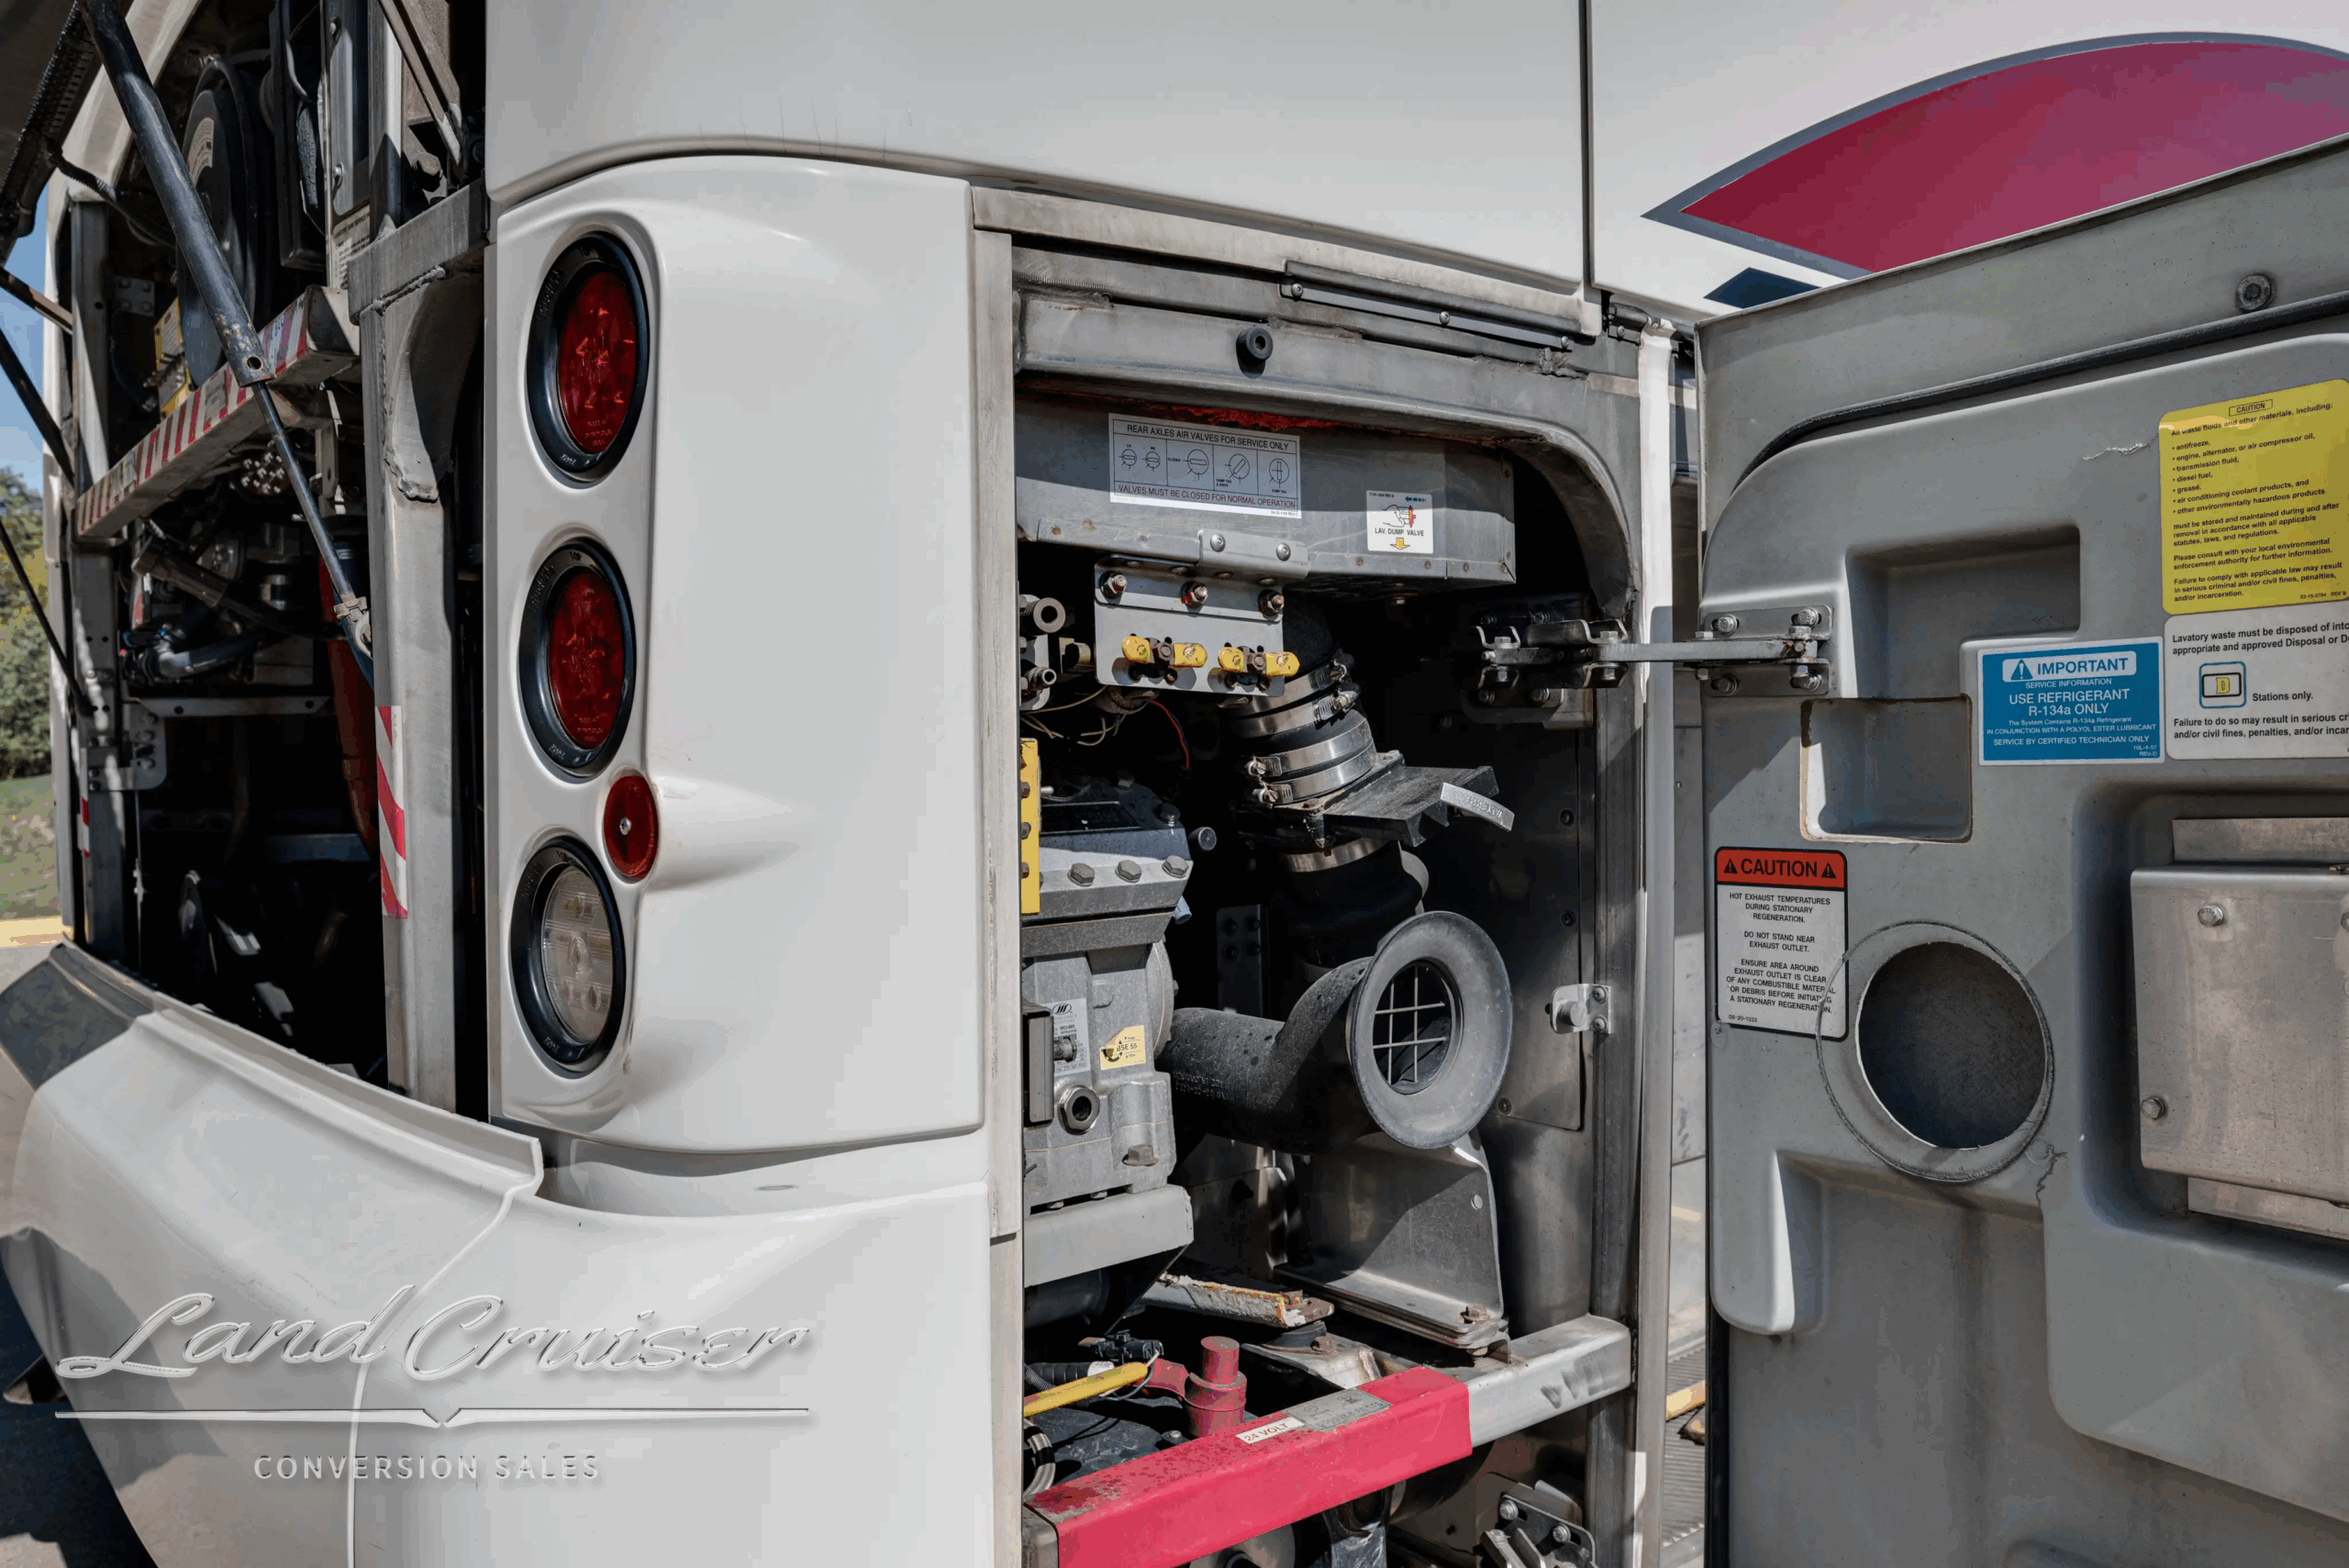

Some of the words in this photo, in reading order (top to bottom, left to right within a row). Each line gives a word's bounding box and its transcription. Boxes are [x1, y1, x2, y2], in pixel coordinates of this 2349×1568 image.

[2236, 402, 2266, 414] CAUTION
[1127, 424, 1148, 434] REAR
[1150, 427, 1174, 437] AXLES
[1176, 430, 1188, 439] AIR
[1190, 431, 1219, 442] VALVES
[1220, 435, 1235, 444] FOR
[1237, 437, 1268, 448] SERVICE
[1269, 440, 1288, 450] ONLY
[2258, 435, 2302, 448] compressor
[2176, 460, 2220, 472] transmission
[2176, 473, 2197, 483] diesel
[1118, 484, 1147, 495] VALVES
[1148, 487, 1169, 496] MUST
[1170, 489, 1180, 497] BE
[1181, 490, 1209, 500] CLOSED
[1211, 493, 1226, 504] FOR
[1227, 495, 1255, 505] NORMAL
[1257, 497, 1296, 509] OPERATION
[2187, 491, 2230, 502] conditioning
[2231, 486, 2257, 495] coolant
[2196, 498, 2251, 511] environmentally
[2253, 494, 2290, 503] hazardous
[2292, 488, 2325, 499] products
[2201, 517, 2223, 526] stored
[2239, 509, 2279, 521] maintained
[2280, 507, 2304, 516] during
[2173, 528, 2200, 538] removal
[2210, 524, 2250, 533] accordance
[2278, 514, 2316, 525] applicable
[2197, 550, 2222, 559] consult
[2258, 543, 2276, 551] local
[2277, 538, 2330, 550] environmental
[569, 551, 582, 561] TOP
[2173, 560, 2216, 570] enforcement
[2217, 556, 2248, 565] authority
[2207, 573, 2232, 582] comply
[2250, 567, 2287, 578] applicable
[2320, 562, 2342, 570] result
[2208, 581, 2236, 590] criminal
[2237, 579, 2261, 587] and/or
[2172, 633, 2209, 642] Lavatory
[2210, 630, 2235, 639] waste
[2238, 628, 2260, 638] must
[2262, 628, 2273, 636] be
[2276, 624, 2318, 635] disposed
[2320, 623, 2330, 631] of
[2172, 644, 2221, 656] appropriate
[2222, 642, 2239, 651] and
[2241, 639, 2283, 651] approved
[2286, 635, 2325, 647] Disposal
[2037, 657, 2128, 674] IMPORTANT
[2025, 680, 2056, 689] SERVICE
[2058, 677, 2111, 687] INFORMATION
[2216, 677, 2230, 694] D
[2009, 693, 2033, 705] USE
[2038, 688, 2130, 703] REFRIGERANT
[2252, 693, 2289, 701] Stations
[2291, 692, 2313, 701] only.
[2029, 705, 2071, 716] R-134a
[2074, 702, 2109, 715] ONLY
[2116, 723, 2156, 731] LUBRICANT
[2174, 717, 2202, 727] Failure
[2204, 717, 2213, 726] to
[2215, 717, 2226, 725] do
[2242, 717, 2260, 726] may
[2262, 715, 2288, 724] result
[2301, 714, 2336, 722] serious
[2174, 729, 2200, 739] and/or
[2202, 729, 2220, 738] civil
[2221, 728, 2245, 738] fines,
[2248, 728, 2291, 738] penalties,
[2293, 727, 2323, 735] and/or
[1993, 738, 2024, 746] SERVICE
[1741, 858, 1817, 877] CAUTION
[1744, 893, 1775, 901] EXHAUST
[1776, 895, 1830, 905] TEMPERATURES
[1773, 904, 1813, 914] STATIONARY
[1753, 912, 1805, 923] REGENERATION.
[1772, 932, 1794, 941] STAND
[1749, 940, 1779, 949] EXHAUST
[1781, 943, 1809, 951] OUTLET.
[1741, 958, 1766, 967] ENSURE
[1789, 963, 1819, 973] AROUND
[1734, 967, 1764, 976] EXHAUST
[1765, 971, 1792, 979] OUTLET
[1803, 974, 1826, 983] CLEAR
[1753, 978, 1799, 990] COMBUSTIBLE
[1742, 986, 1765, 995] DEBRIS
[1768, 990, 1794, 999] BEFORE
[1737, 995, 1776, 1006] STATIONARY
[1244, 1433, 1259, 1441] 24
[1259, 1423, 1289, 1436] VOLT
